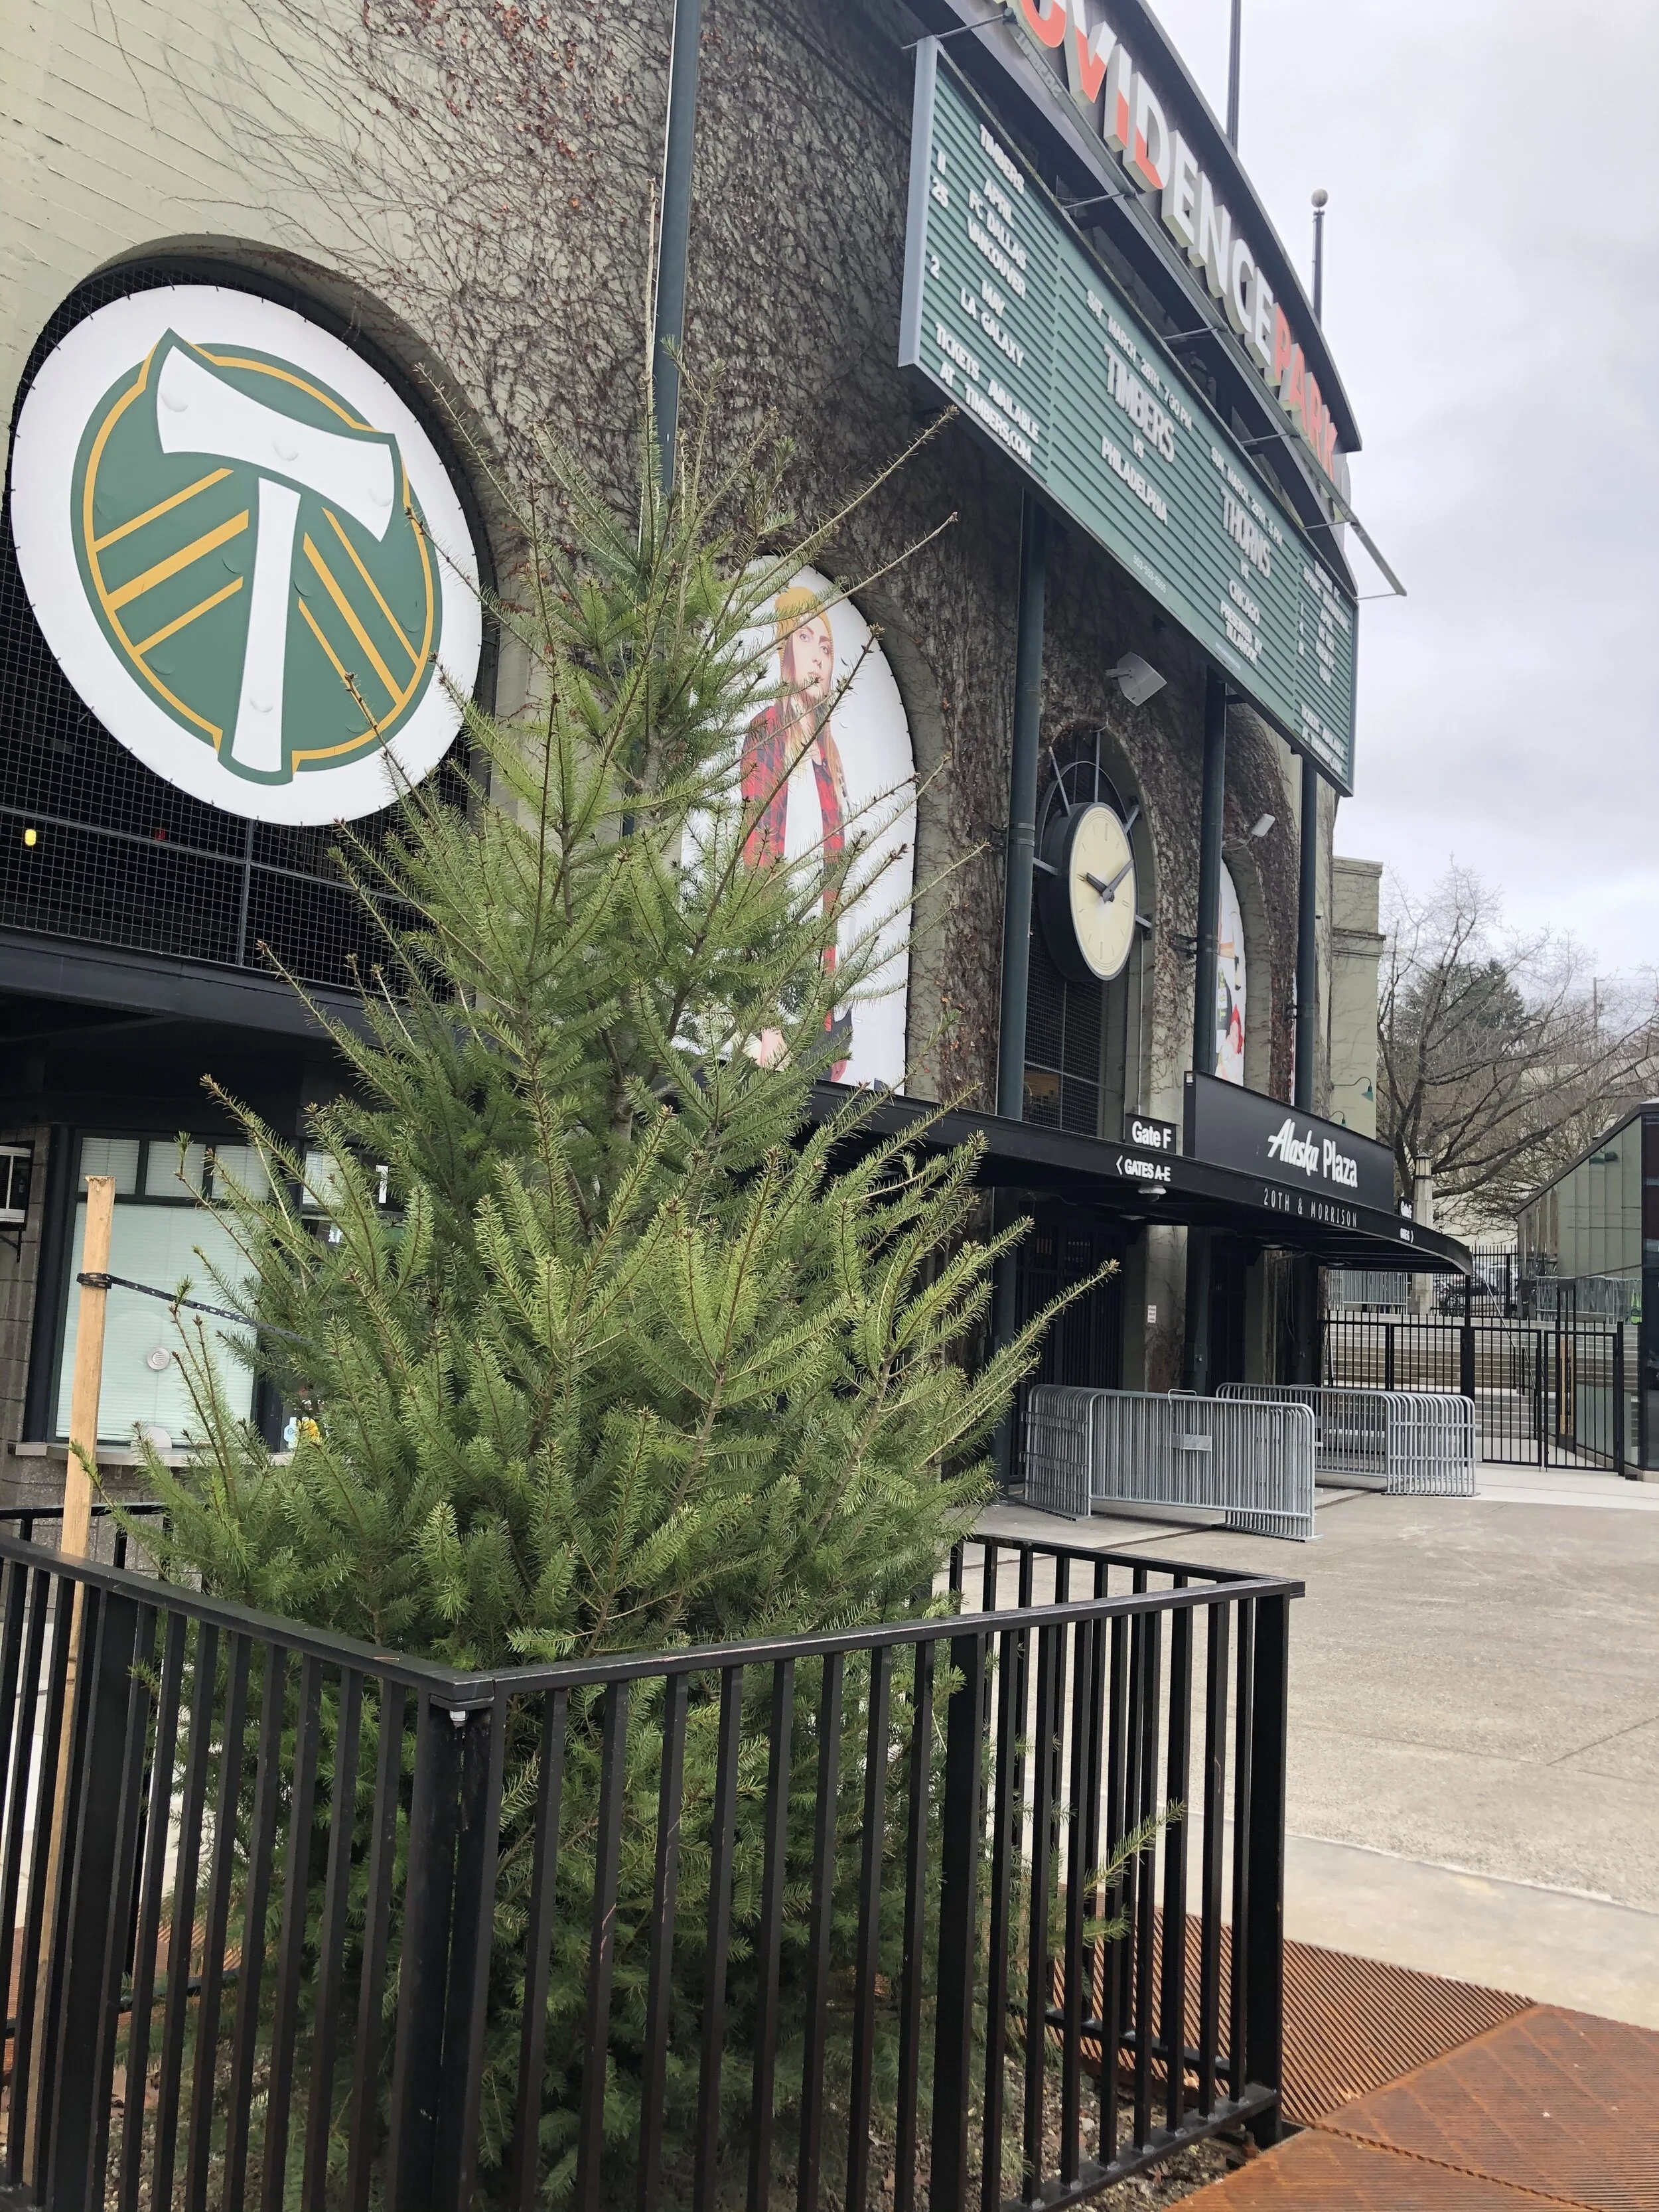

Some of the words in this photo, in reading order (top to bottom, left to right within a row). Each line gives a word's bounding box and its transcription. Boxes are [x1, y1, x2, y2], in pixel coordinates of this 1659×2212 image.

[980, 123, 1025, 194] TIMBERS
[932, 176, 948, 208] 25
[968, 216, 1026, 300] VANCOUVER
[969, 188, 983, 220] FC
[987, 210, 1027, 270] DALLAS
[983, 179, 1014, 229] APRIL
[930, 255, 940, 279] 2
[961, 287, 977, 320] LA
[981, 312, 1024, 368] GALAXY
[981, 279, 1005, 317] MAY
[935, 322, 979, 382] TICKETS
[988, 380, 1039, 443] AVAILABLE
[1086, 289, 1103, 319] SAT
[1108, 315, 1137, 362] MARCH
[1141, 358, 1159, 391] 28TH
[1180, 409, 1192, 431] PM
[1273, 302, 1338, 486] PARK
[940, 361, 955, 388] AT
[965, 383, 1031, 464] TIMBERS.COM
[1104, 343, 1175, 463] TIMBERS
[1102, 436, 1168, 526] PHILADELPHIA
[1133, 434, 1144, 459] VS
[1211, 447, 1224, 472] SUN
[1228, 466, 1249, 504] MARCH
[1273, 526, 1283, 548] PM
[1220, 486, 1271, 578] THORNS
[1229, 579, 1260, 626] CHICAGO
[1240, 559, 1249, 579] VS
[1220, 600, 1252, 644] PRESENTED
[1254, 636, 1262, 655] BY
[1226, 621, 1257, 666] TILLAMOOK
[1124, 1159, 1154, 1179] GATES
[1155, 1165, 1171, 1181] A-E
[1132, 1121, 1161, 1147] Gate
[1163, 1128, 1172, 1149] F
[1267, 1118, 1319, 1176] Alaska
[1323, 1138, 1358, 1188] Plaza
[1263, 1188, 1289, 1211] 20TH
[1298, 1197, 1303, 1215] &
[1311, 1201, 1357, 1228] MORRISON
